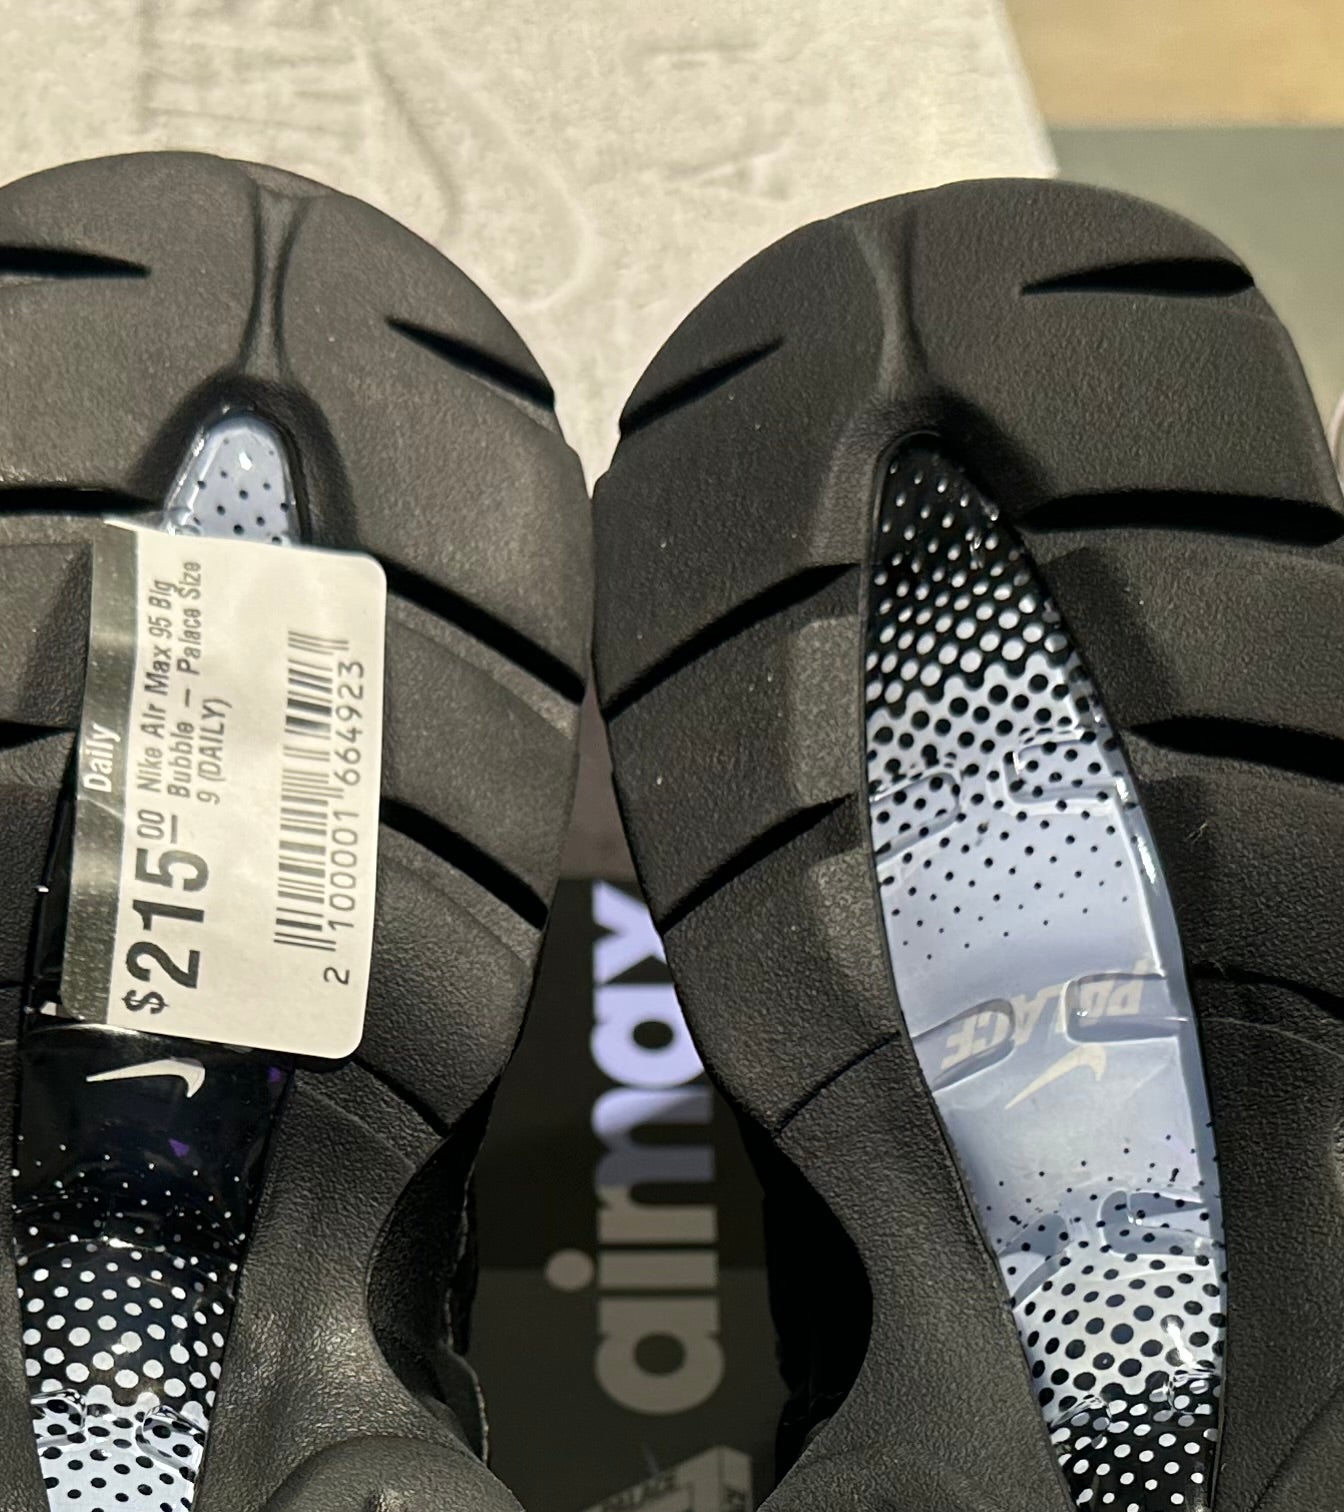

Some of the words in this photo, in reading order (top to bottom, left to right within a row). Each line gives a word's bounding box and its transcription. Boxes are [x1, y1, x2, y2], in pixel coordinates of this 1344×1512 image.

[148, 580, 180, 610] Big
[178, 561, 202, 601] Size
[148, 614, 173, 640] 95
[177, 608, 202, 676] Palace
[144, 648, 172, 696] Max
[140, 705, 167, 739] Air
[198, 698, 233, 783] (DAILY)
[333, 660, 365, 788] 664923
[83, 722, 121, 793] Daily
[137, 749, 163, 793] Nike
[167, 721, 195, 798] Bubble
[196, 790, 221, 806] 9
[328, 809, 360, 931] 100001
[323, 966, 351, 986] 2
